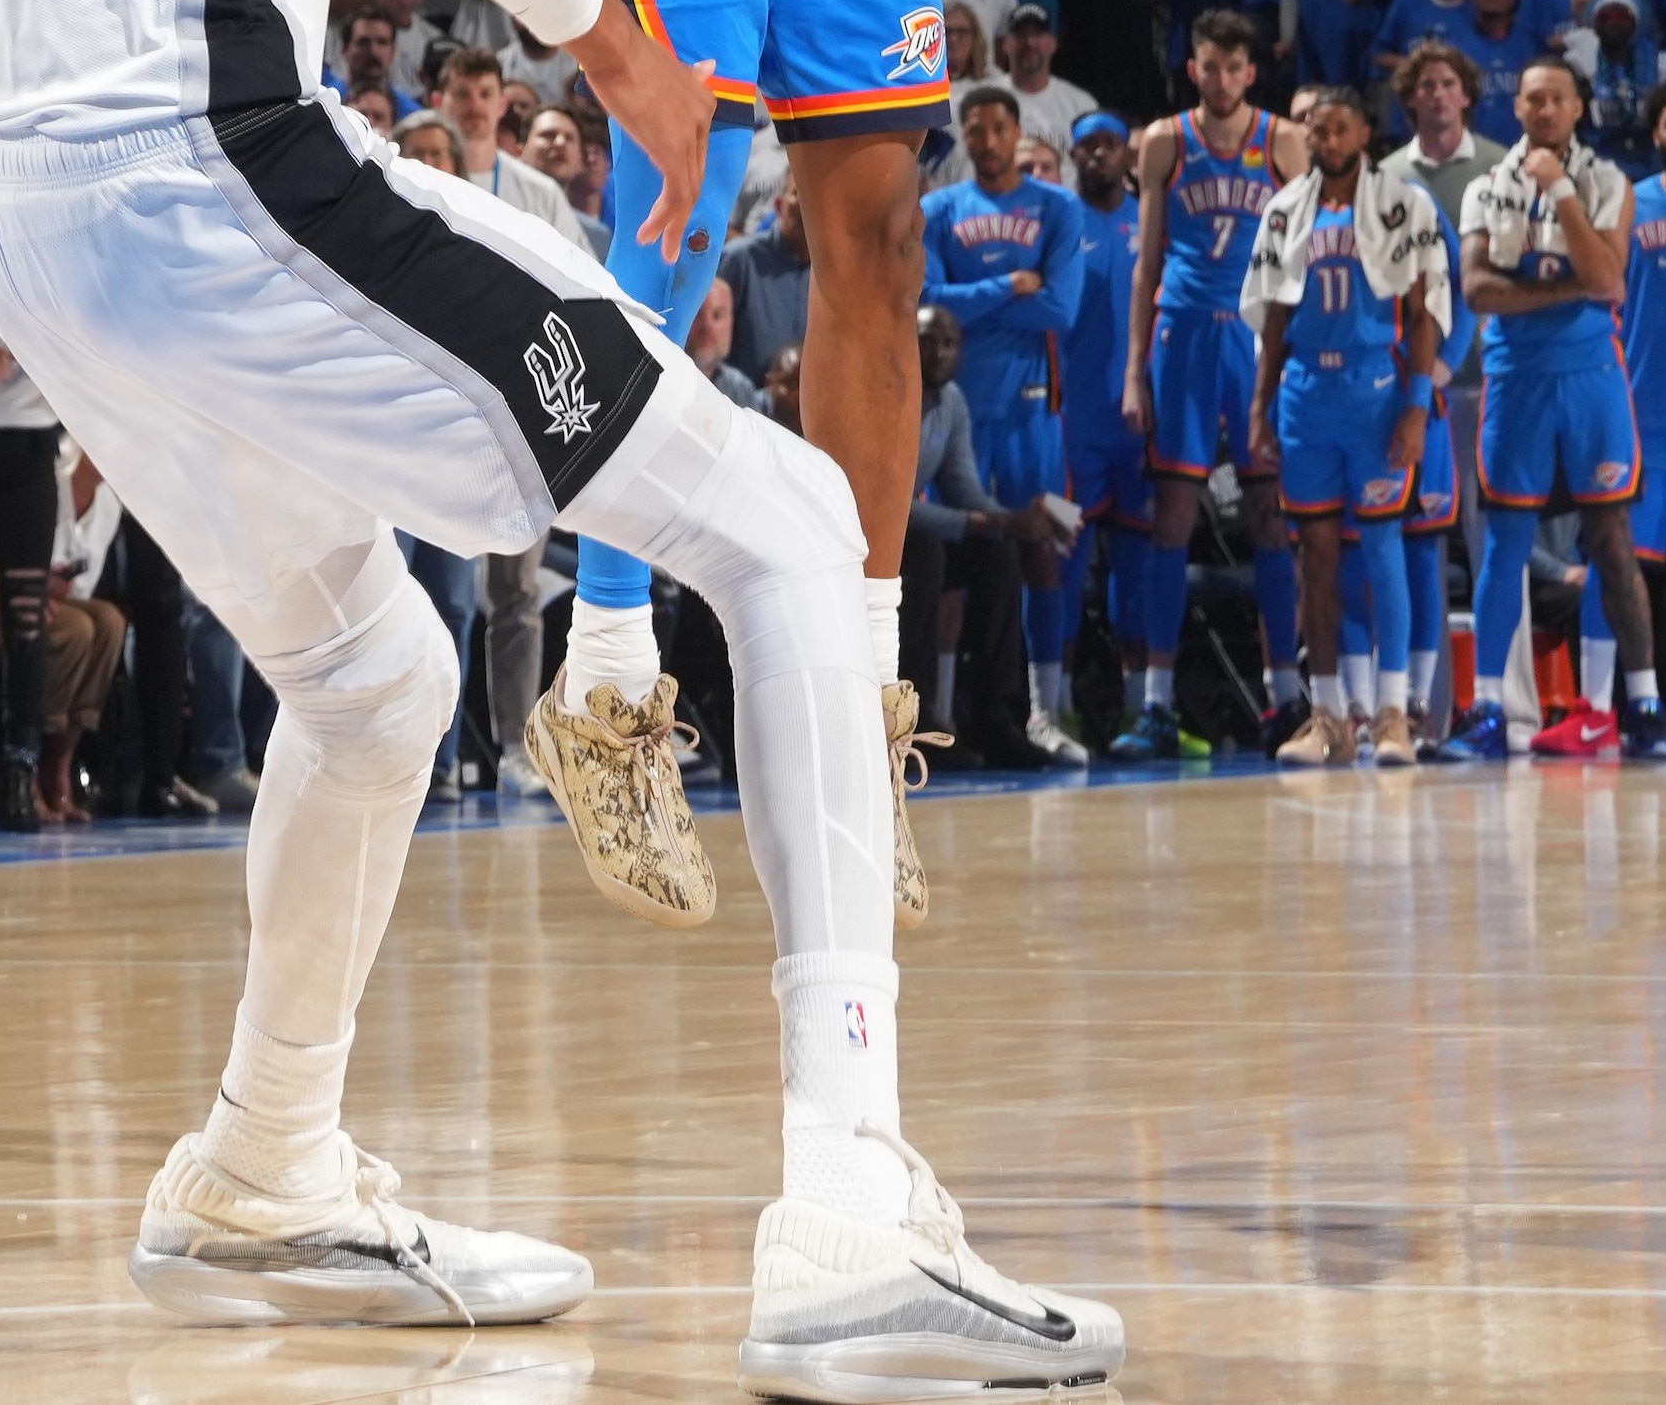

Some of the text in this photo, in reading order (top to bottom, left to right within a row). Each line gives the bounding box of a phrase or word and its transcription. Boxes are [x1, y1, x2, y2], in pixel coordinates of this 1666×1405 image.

[906, 21, 940, 62] OKC
[953, 212, 1041, 248] THUNDER
[1211, 215, 1235, 260] 7
[1317, 266, 1351, 313] 11
